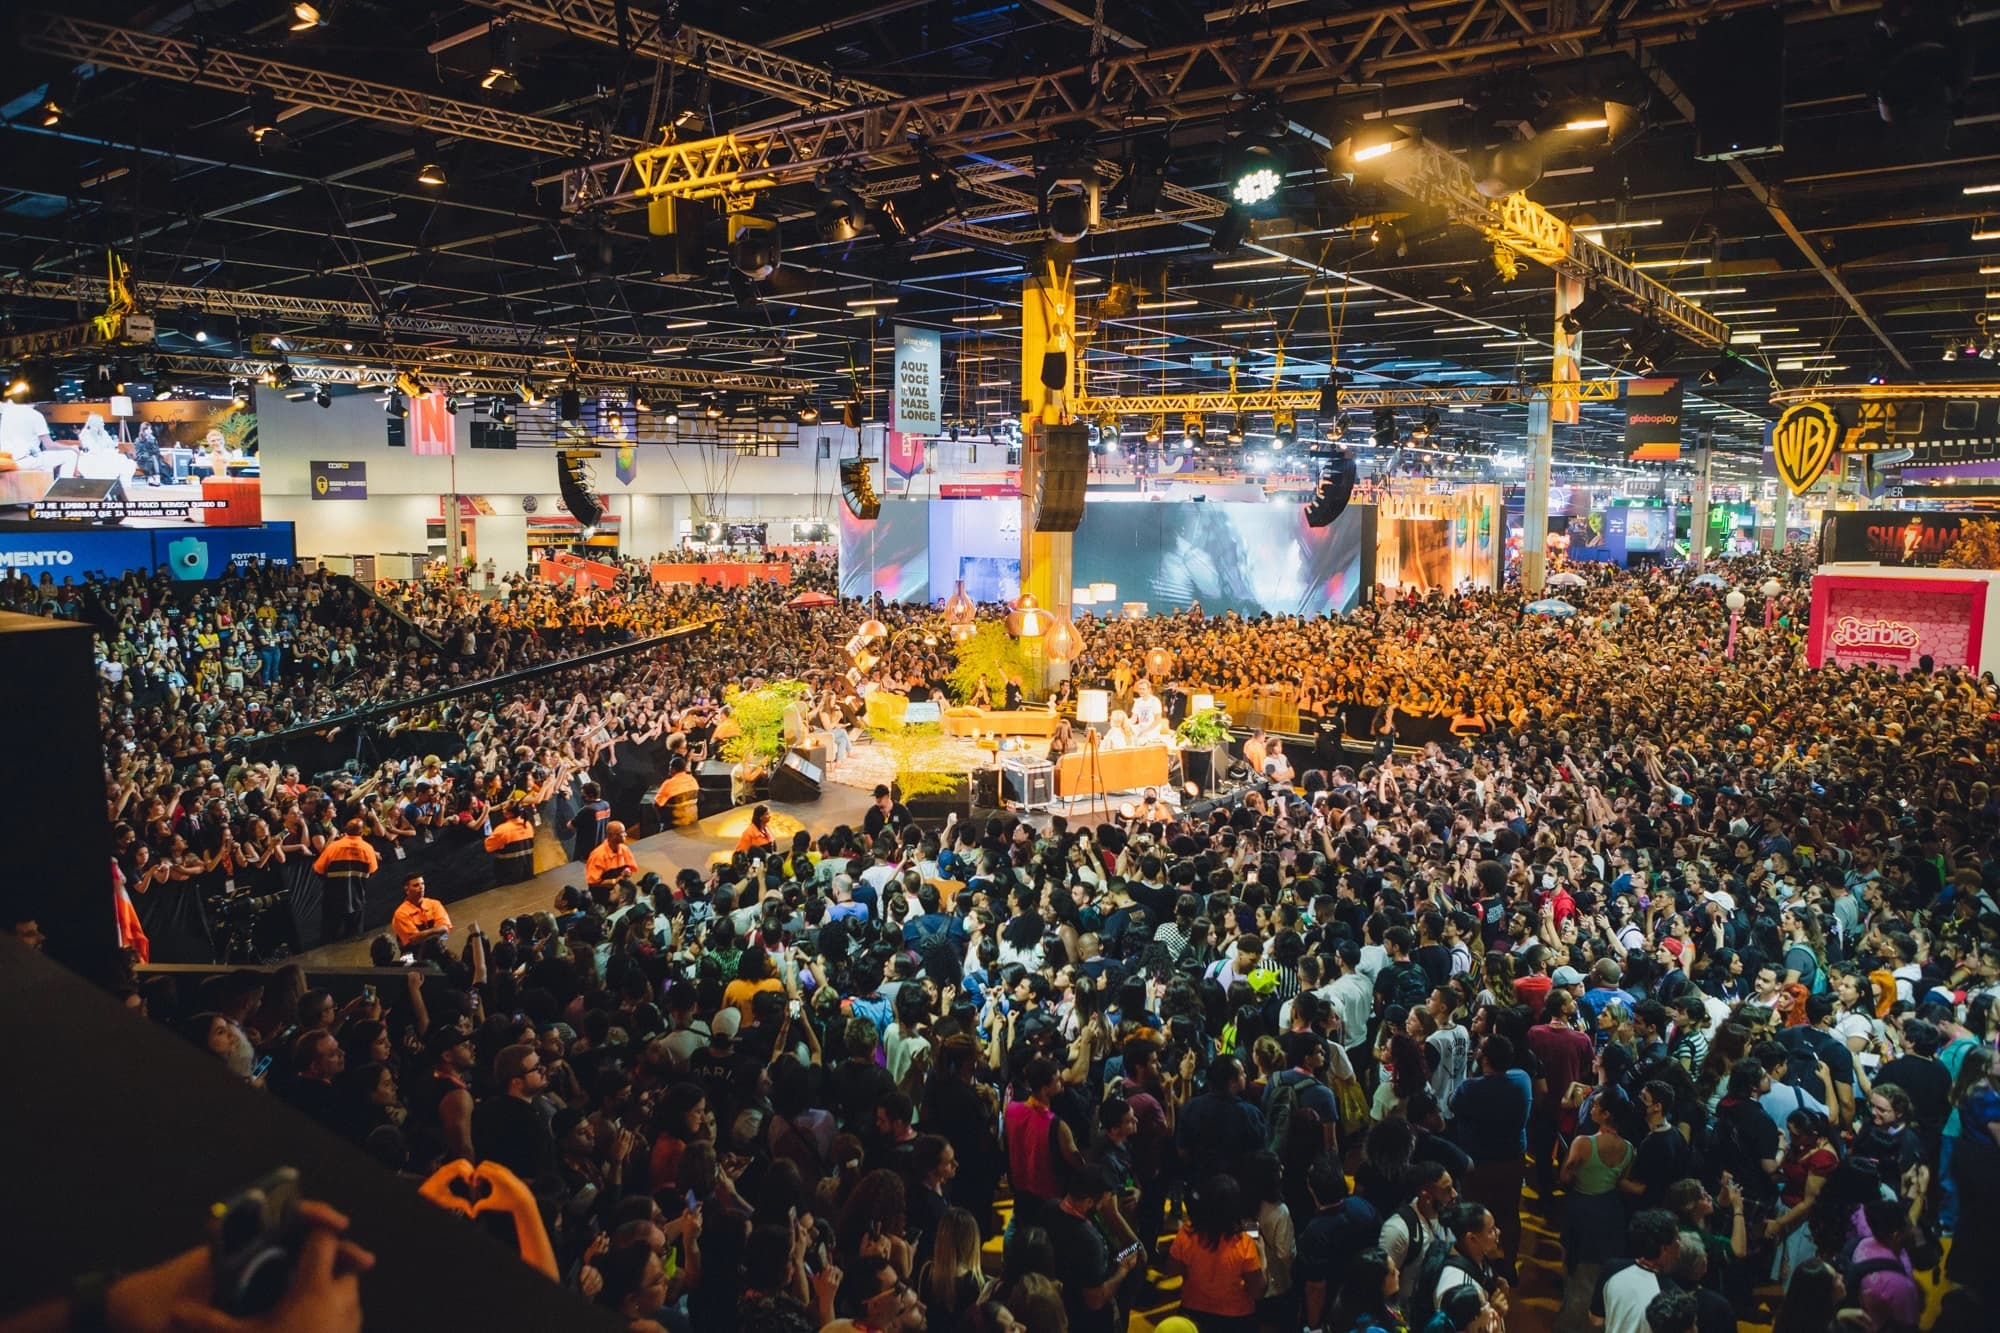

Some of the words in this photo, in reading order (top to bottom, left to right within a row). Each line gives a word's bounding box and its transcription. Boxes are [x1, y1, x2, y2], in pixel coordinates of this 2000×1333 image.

[901, 360, 928, 372] AQUI
[901, 372, 929, 385] VOCÊ
[908, 386, 928, 397] VAI
[901, 398, 929, 409] MAIS
[421, 395, 445, 441] N
[901, 409, 936, 421] LONGE
[1629, 413, 1678, 425] globoplay
[1780, 415, 1825, 479] WB
[1835, 621, 1915, 645] Barbie
